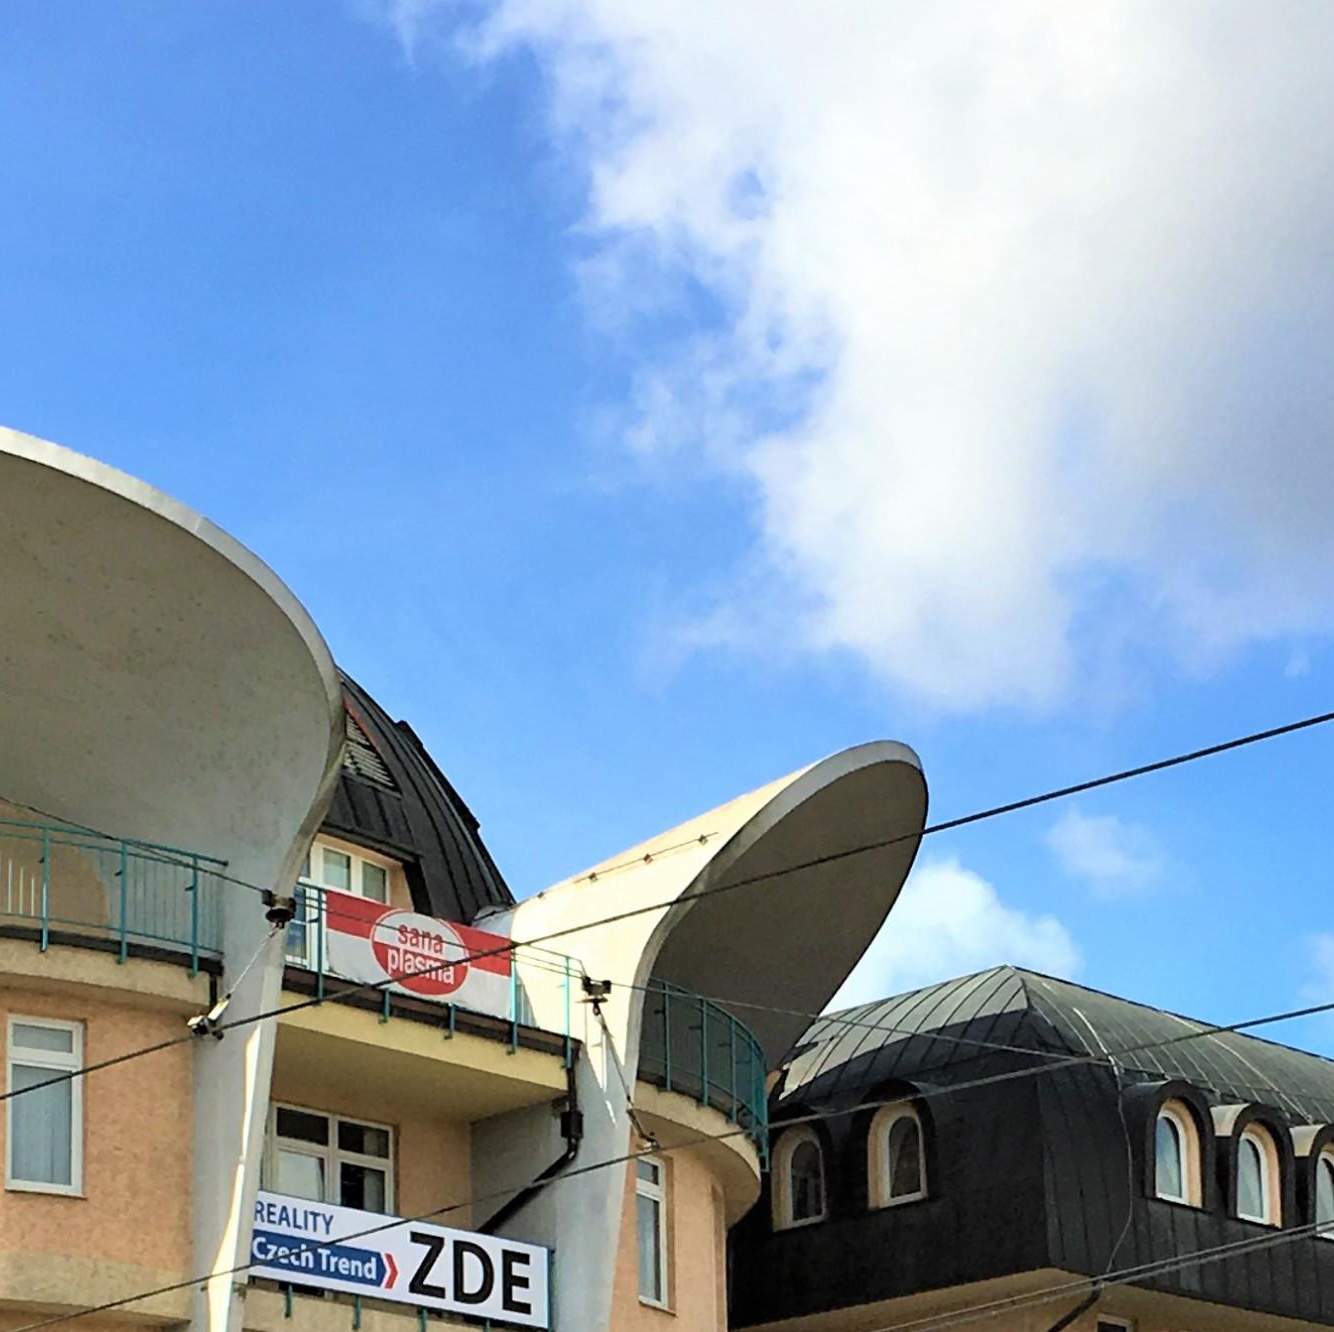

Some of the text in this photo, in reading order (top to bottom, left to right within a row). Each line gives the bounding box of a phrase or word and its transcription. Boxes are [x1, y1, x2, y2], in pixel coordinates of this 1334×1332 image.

[397, 924, 444, 955] sana
[387, 946, 455, 985] plasma
[254, 1200, 334, 1235] REALITY
[251, 1236, 378, 1281] Czech Trend
[409, 1231, 532, 1315] ZDE
